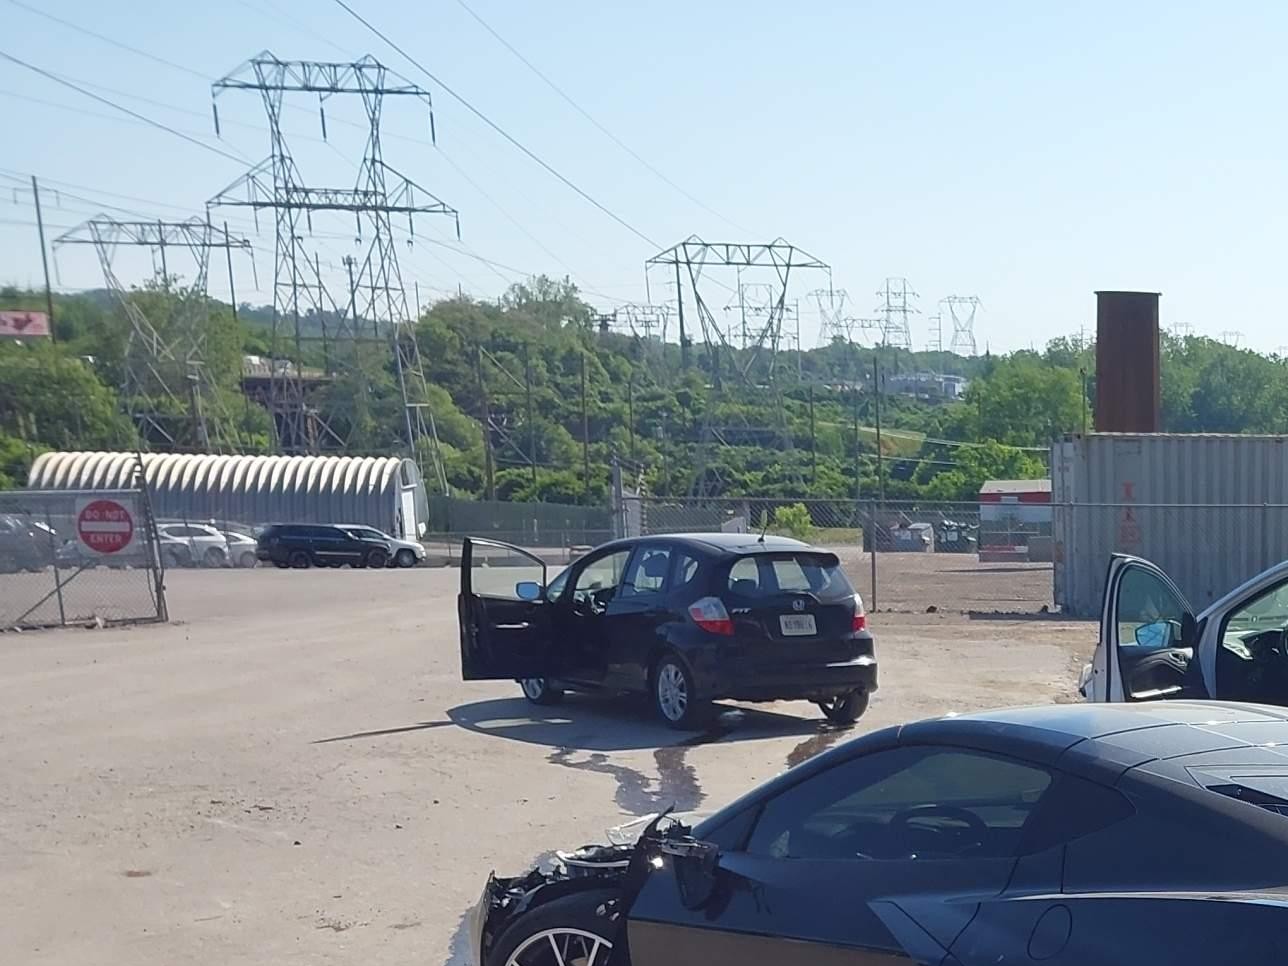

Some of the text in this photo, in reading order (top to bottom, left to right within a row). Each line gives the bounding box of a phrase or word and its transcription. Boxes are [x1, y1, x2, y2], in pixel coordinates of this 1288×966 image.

[85, 510, 125, 520] DO NOT
[90, 533, 122, 544] ENTER
